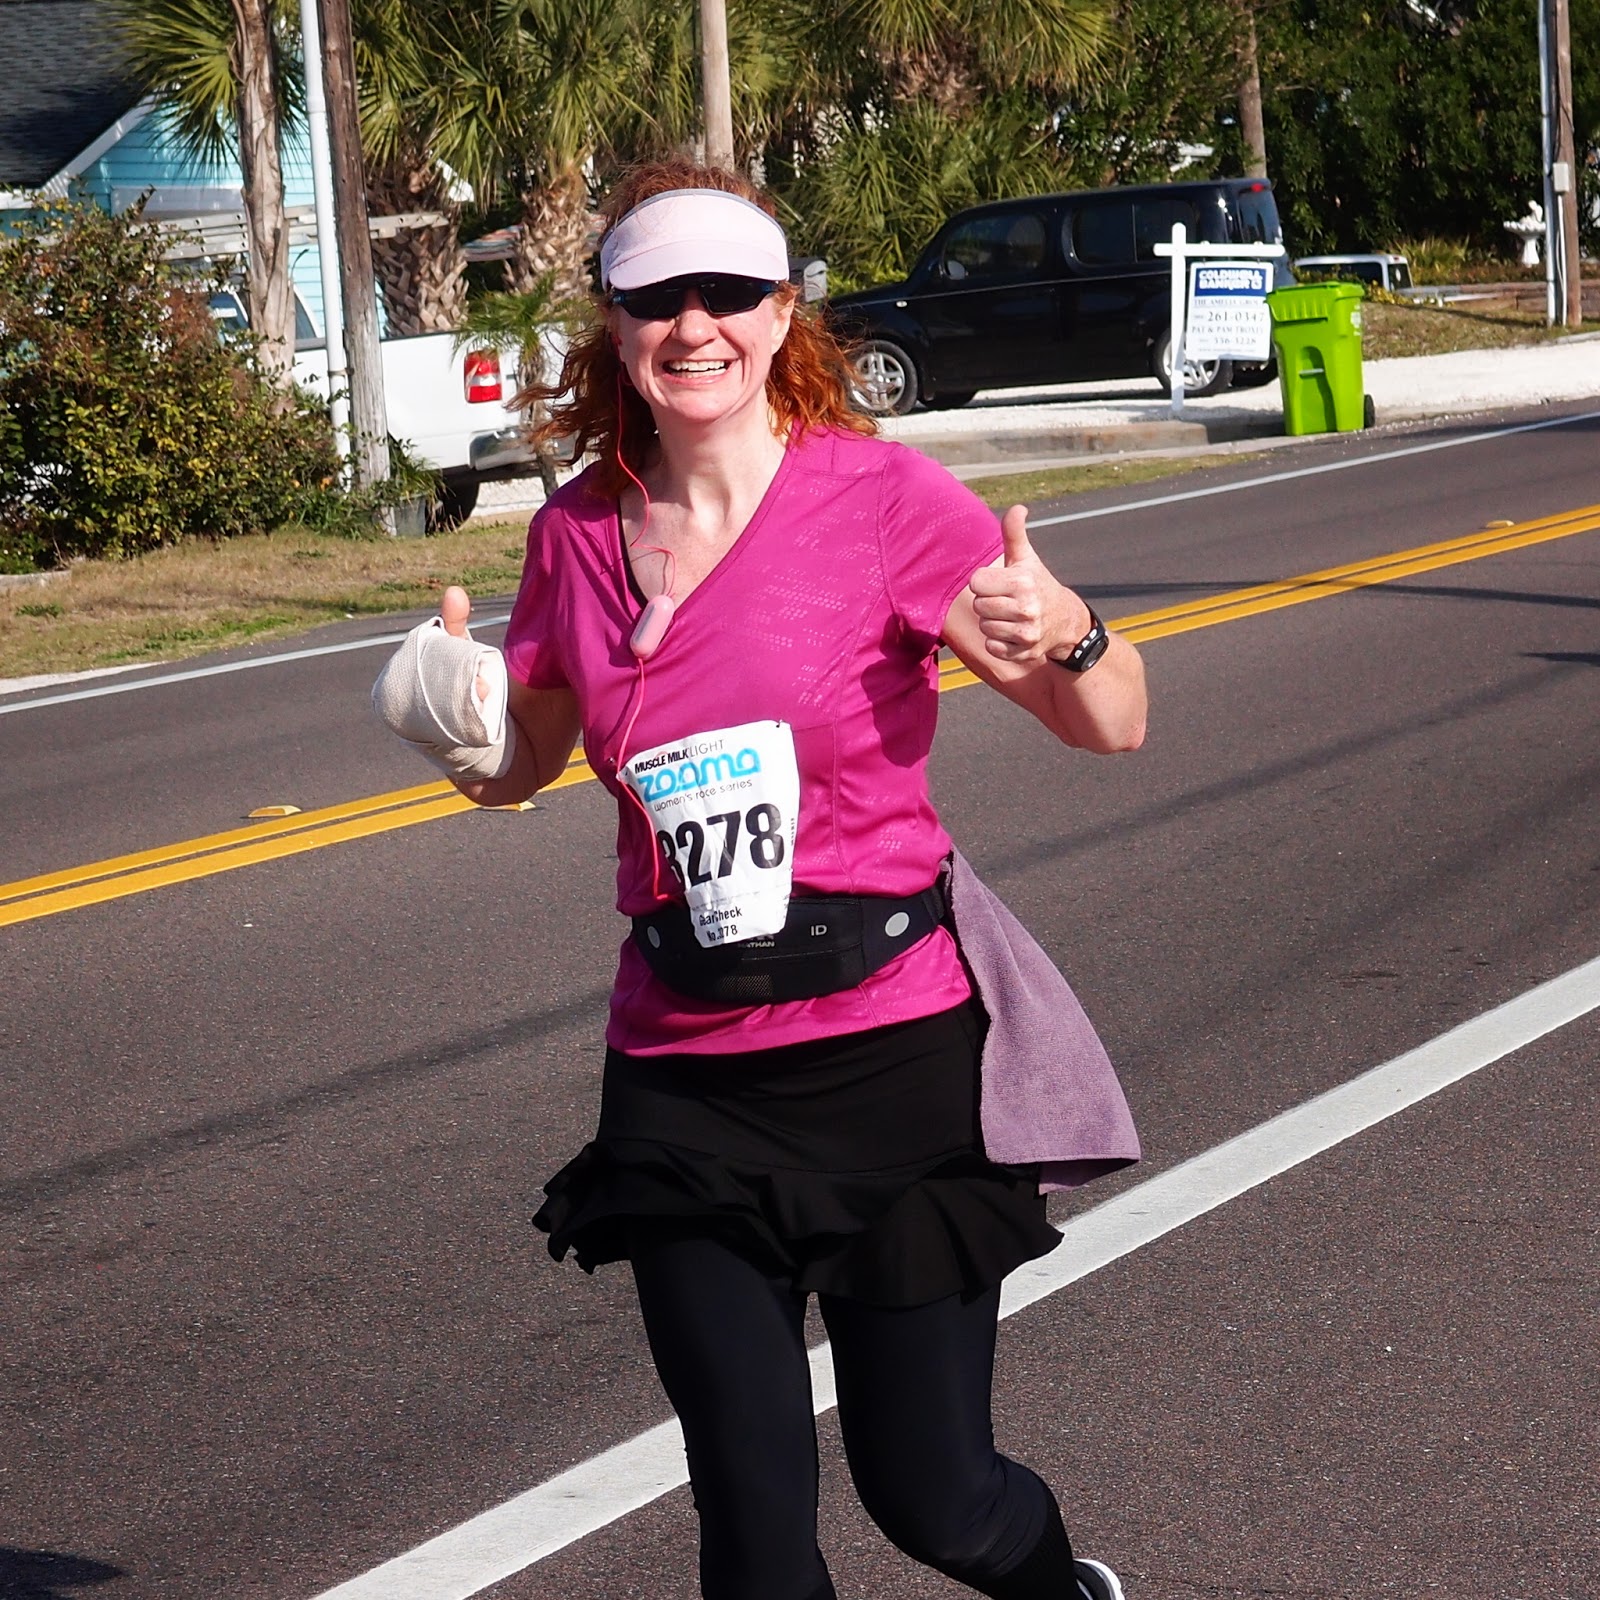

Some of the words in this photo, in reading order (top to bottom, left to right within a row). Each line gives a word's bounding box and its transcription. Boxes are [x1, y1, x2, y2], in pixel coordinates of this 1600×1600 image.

[1199, 270, 1262, 280] COLDWELL
[1199, 279, 1250, 290] BANKER
[1207, 311, 1265, 322] 261-0347
[635, 755, 666, 774] MUSCLE
[653, 791, 694, 812] women's
[695, 786, 717, 799] race
[720, 779, 753, 792] series
[810, 924, 828, 937] ID
